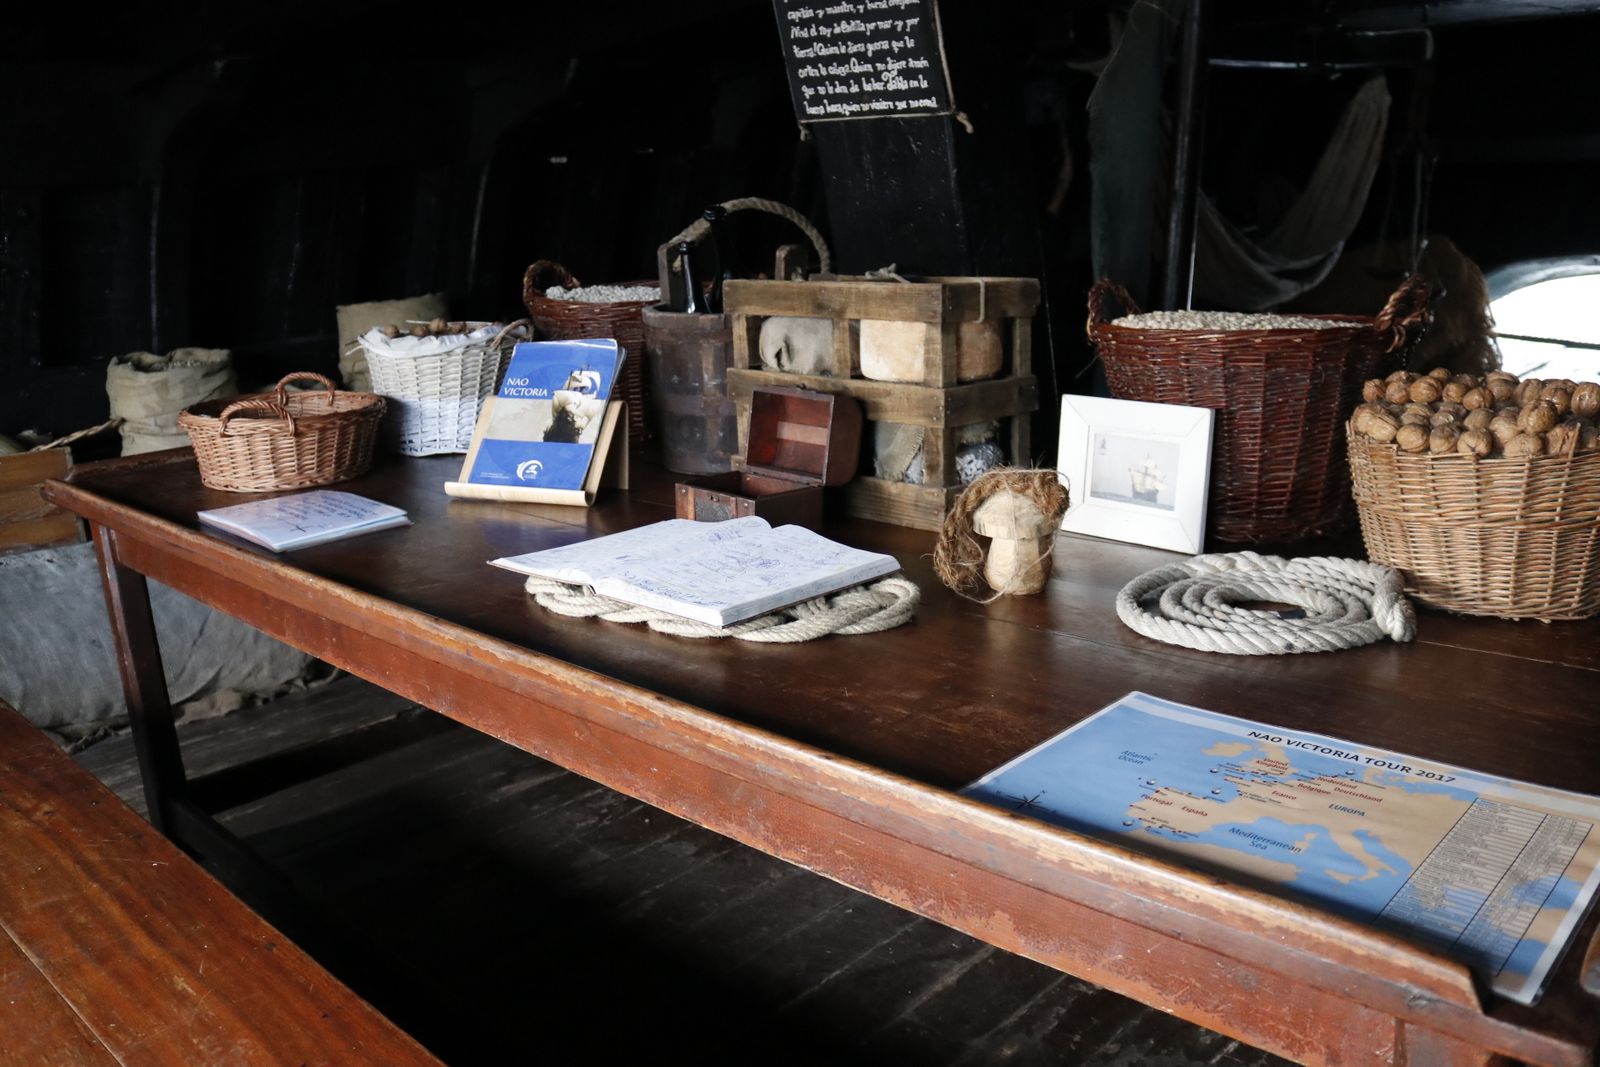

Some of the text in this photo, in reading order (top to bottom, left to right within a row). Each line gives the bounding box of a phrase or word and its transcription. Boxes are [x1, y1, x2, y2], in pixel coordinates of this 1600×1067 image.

[810, 23, 817, 37] el
[866, 22, 877, 35] por
[877, 19, 892, 29] mar
[893, 20, 904, 31] y
[905, 17, 920, 32] por
[866, 40, 890, 57] guerra
[891, 40, 905, 54] que
[801, 85, 815, 99] que
[816, 86, 826, 95] no
[849, 80, 860, 93] de
[507, 377, 529, 386] NAO
[504, 387, 548, 397] VICTORIA
[1118, 755, 1144, 765] Ocean
[1120, 750, 1152, 761] Atlantic
[1248, 731, 1282, 743] NAO
[1286, 738, 1359, 762] VICTORIA
[1364, 757, 1412, 774] TOUR
[1415, 769, 1457, 784] 2017
[1255, 760, 1288, 771] Kingdom
[1263, 758, 1288, 767] United
[1297, 783, 1332, 796] Belgique
[1317, 776, 1358, 790] Nederland
[1141, 793, 1174, 806] Portugal
[1272, 790, 1297, 801] France
[1334, 786, 1383, 803] Deutschland
[1181, 805, 1208, 818] España
[1328, 803, 1366, 817] EUROPA
[1228, 827, 1302, 853] Mediterranean
[1249, 841, 1268, 851] Sea
